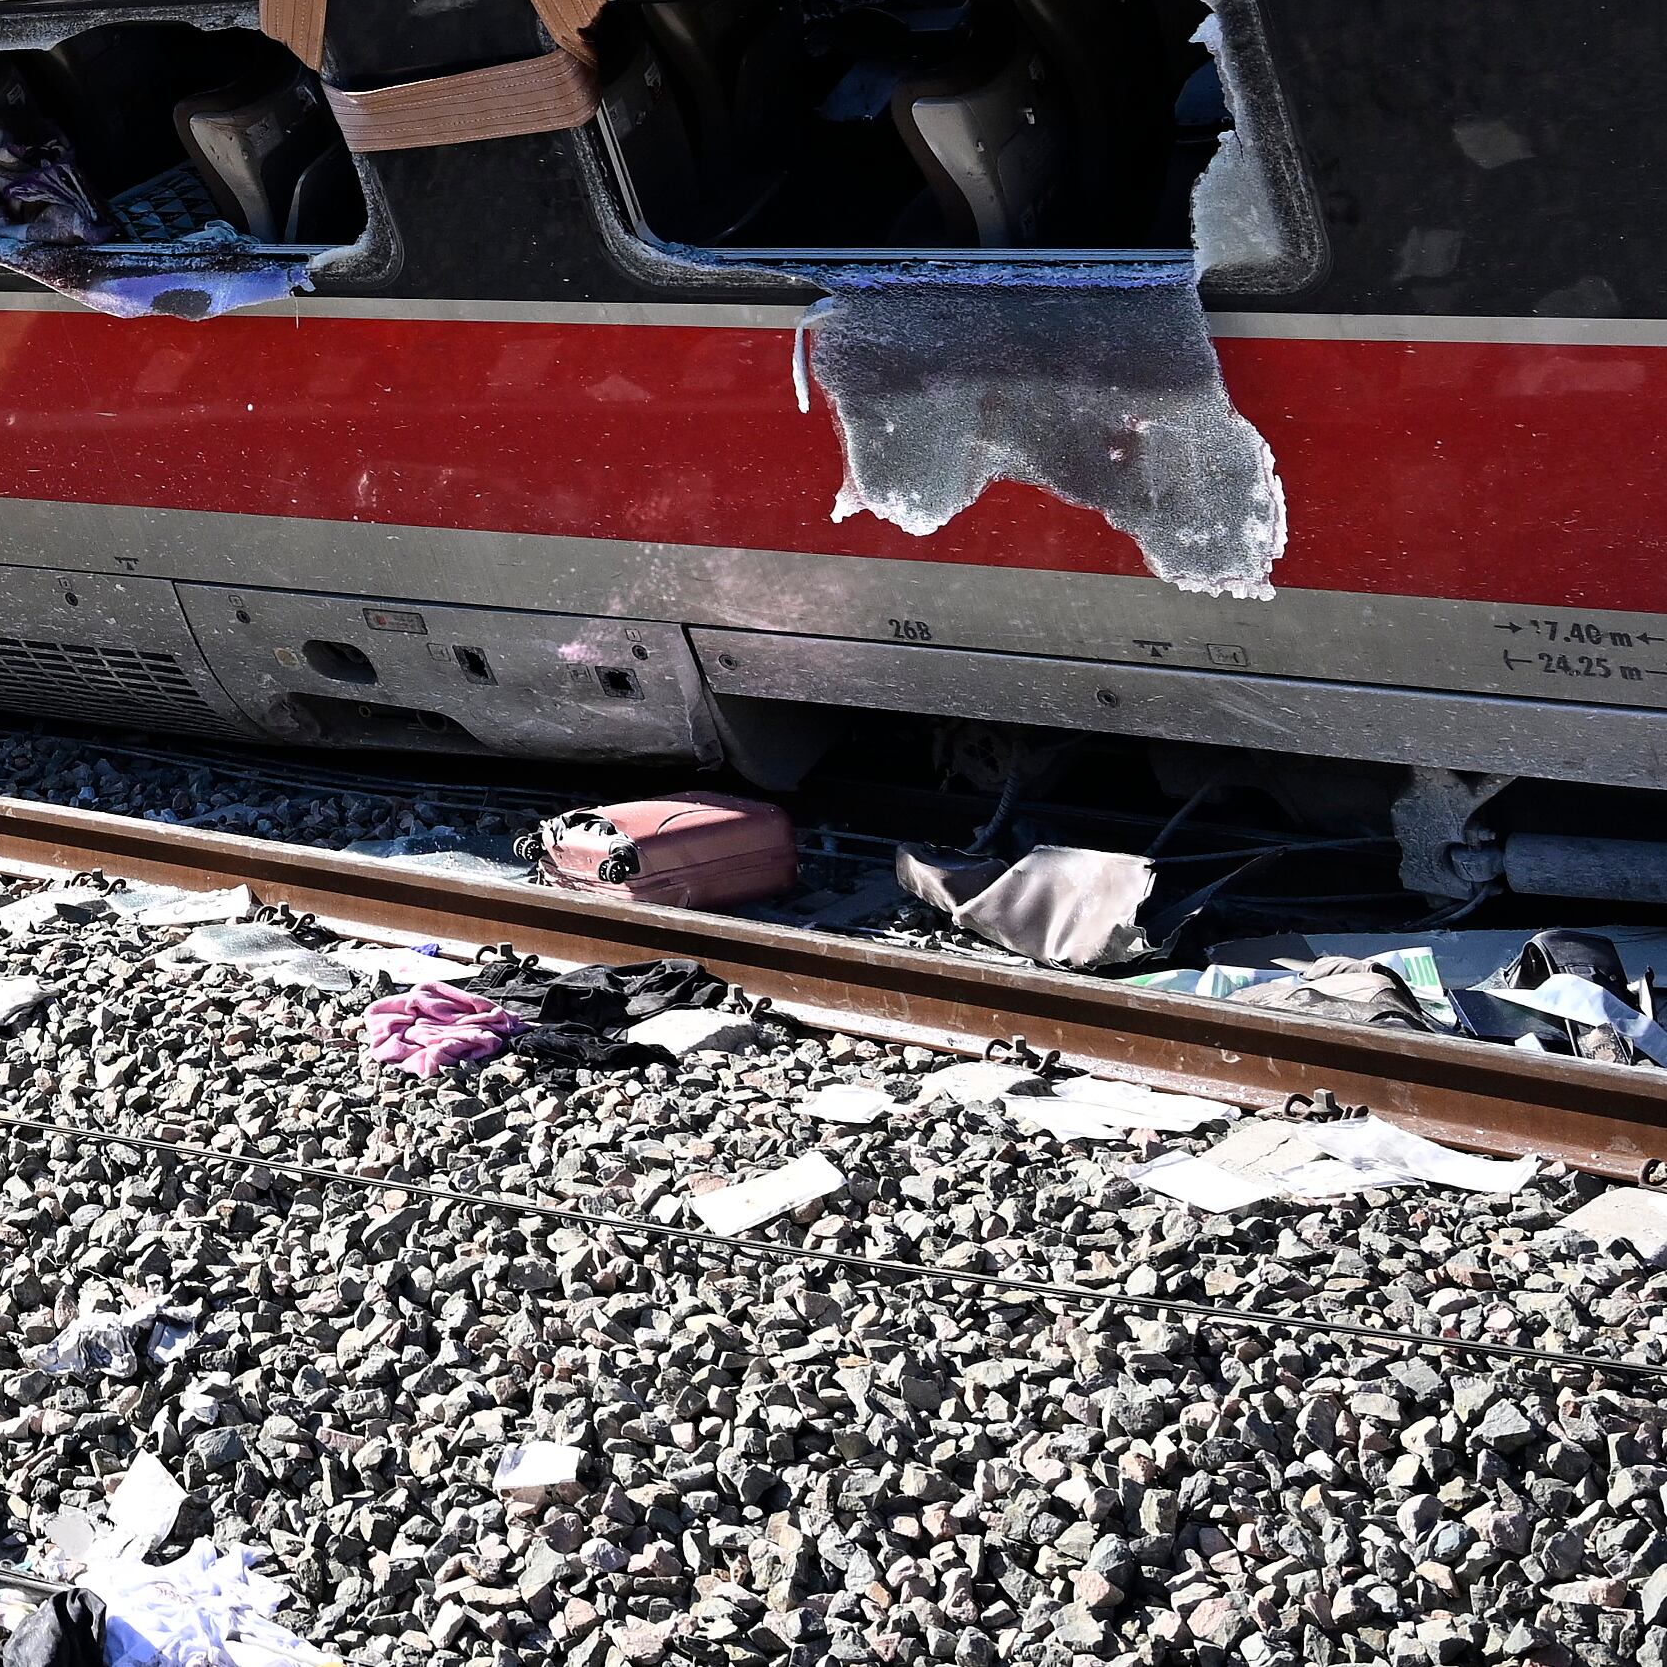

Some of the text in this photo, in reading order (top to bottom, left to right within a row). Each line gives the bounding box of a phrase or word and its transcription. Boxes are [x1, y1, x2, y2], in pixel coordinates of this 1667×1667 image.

[1609, 631, 1633, 647] m
[1538, 652, 1644, 681] 24.25 m
